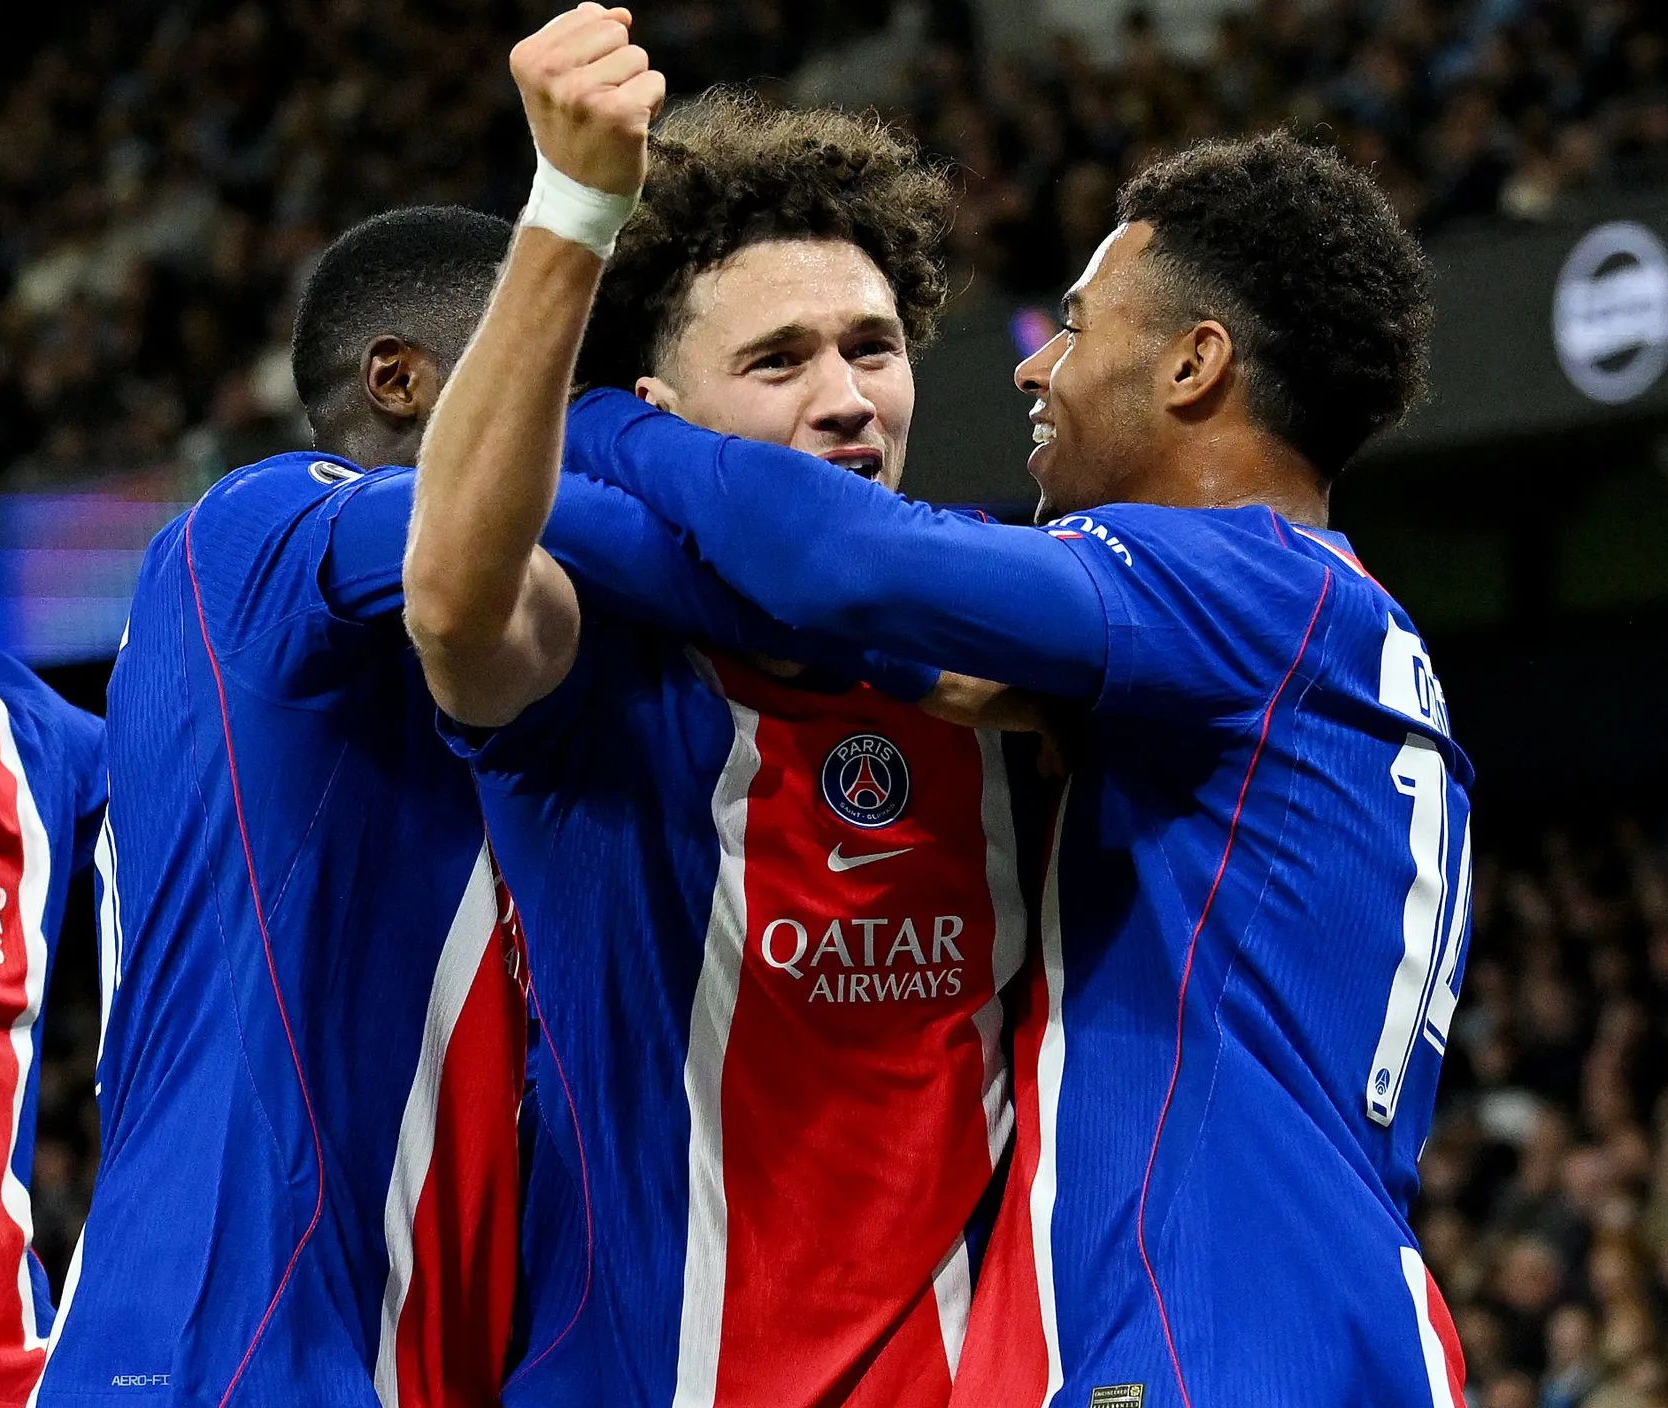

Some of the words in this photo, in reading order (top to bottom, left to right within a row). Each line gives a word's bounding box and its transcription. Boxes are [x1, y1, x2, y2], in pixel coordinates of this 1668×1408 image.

[837, 739, 893, 761] PARIS
[761, 915, 965, 980] QATAR
[808, 967, 963, 1003] AIRWAYS
